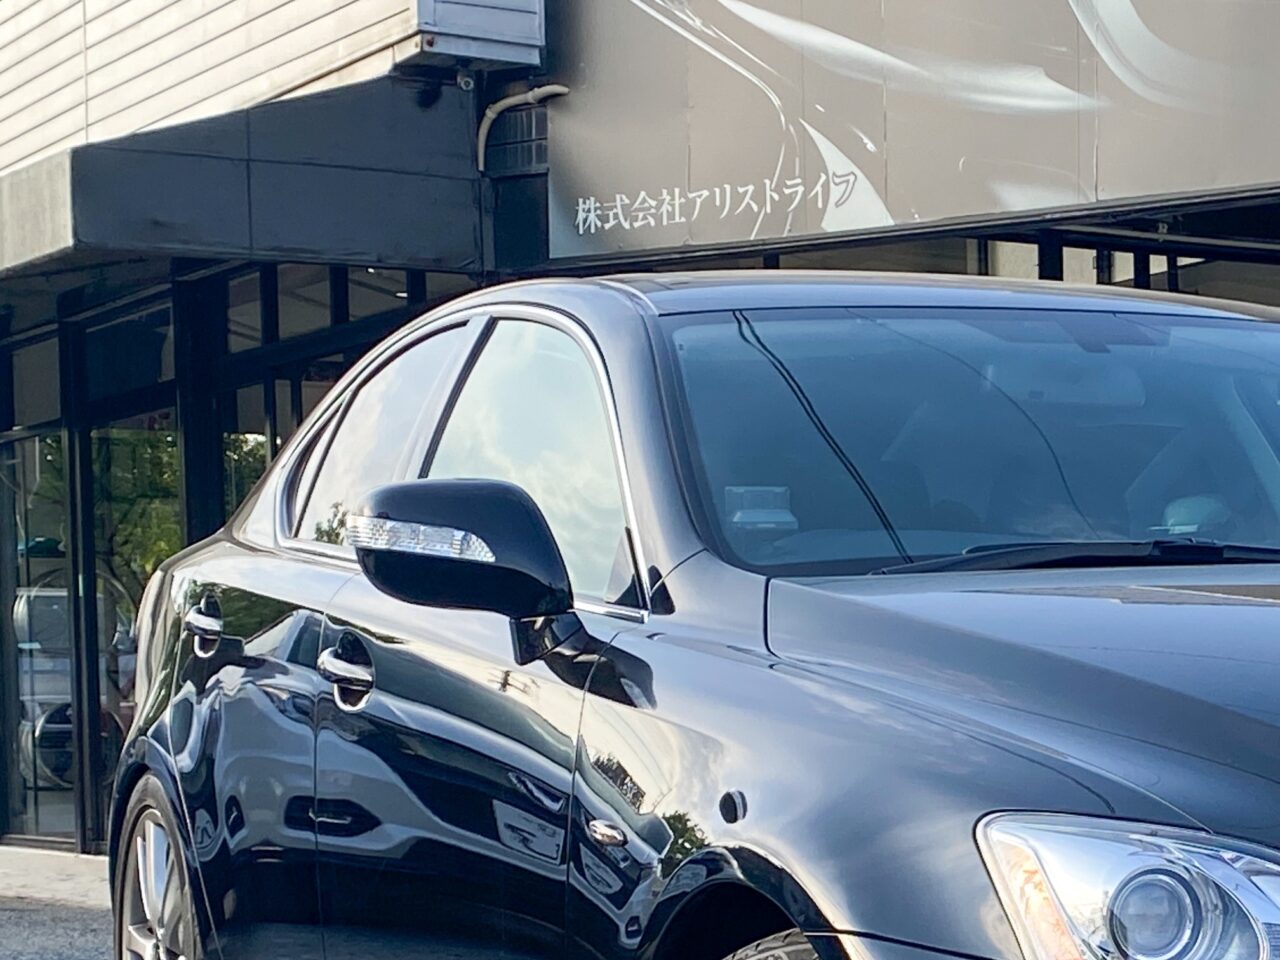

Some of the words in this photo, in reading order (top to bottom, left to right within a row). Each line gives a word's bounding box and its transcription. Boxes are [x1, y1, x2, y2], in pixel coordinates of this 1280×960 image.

[574, 170, 859, 236] 株式会社アリストライフ
